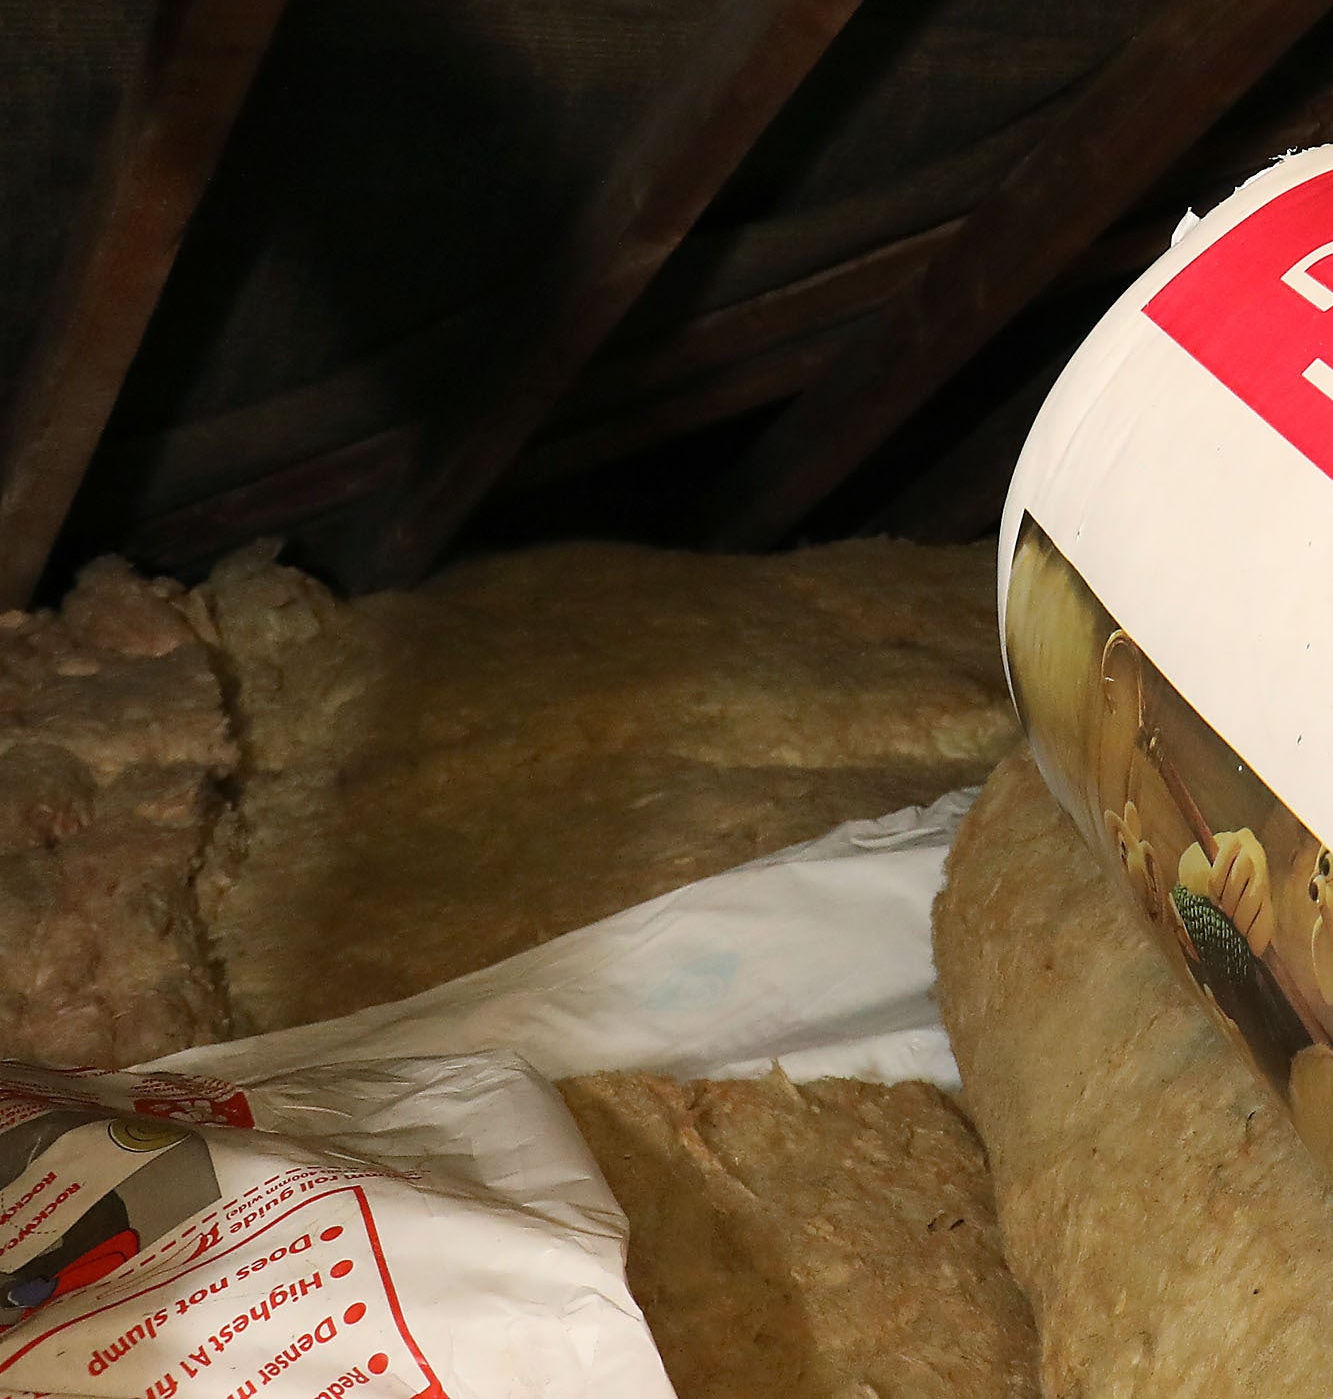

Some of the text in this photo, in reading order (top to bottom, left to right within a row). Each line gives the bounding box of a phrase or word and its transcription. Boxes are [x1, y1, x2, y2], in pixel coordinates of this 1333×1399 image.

[226, 1194, 263, 1221] wide)
[229, 1174, 339, 1234] guide roll
[87, 1233, 313, 1378] Does not slump
[209, 1271, 324, 1356] Highest
[180, 1344, 212, 1379] A1
[257, 1317, 338, 1386] Denser
